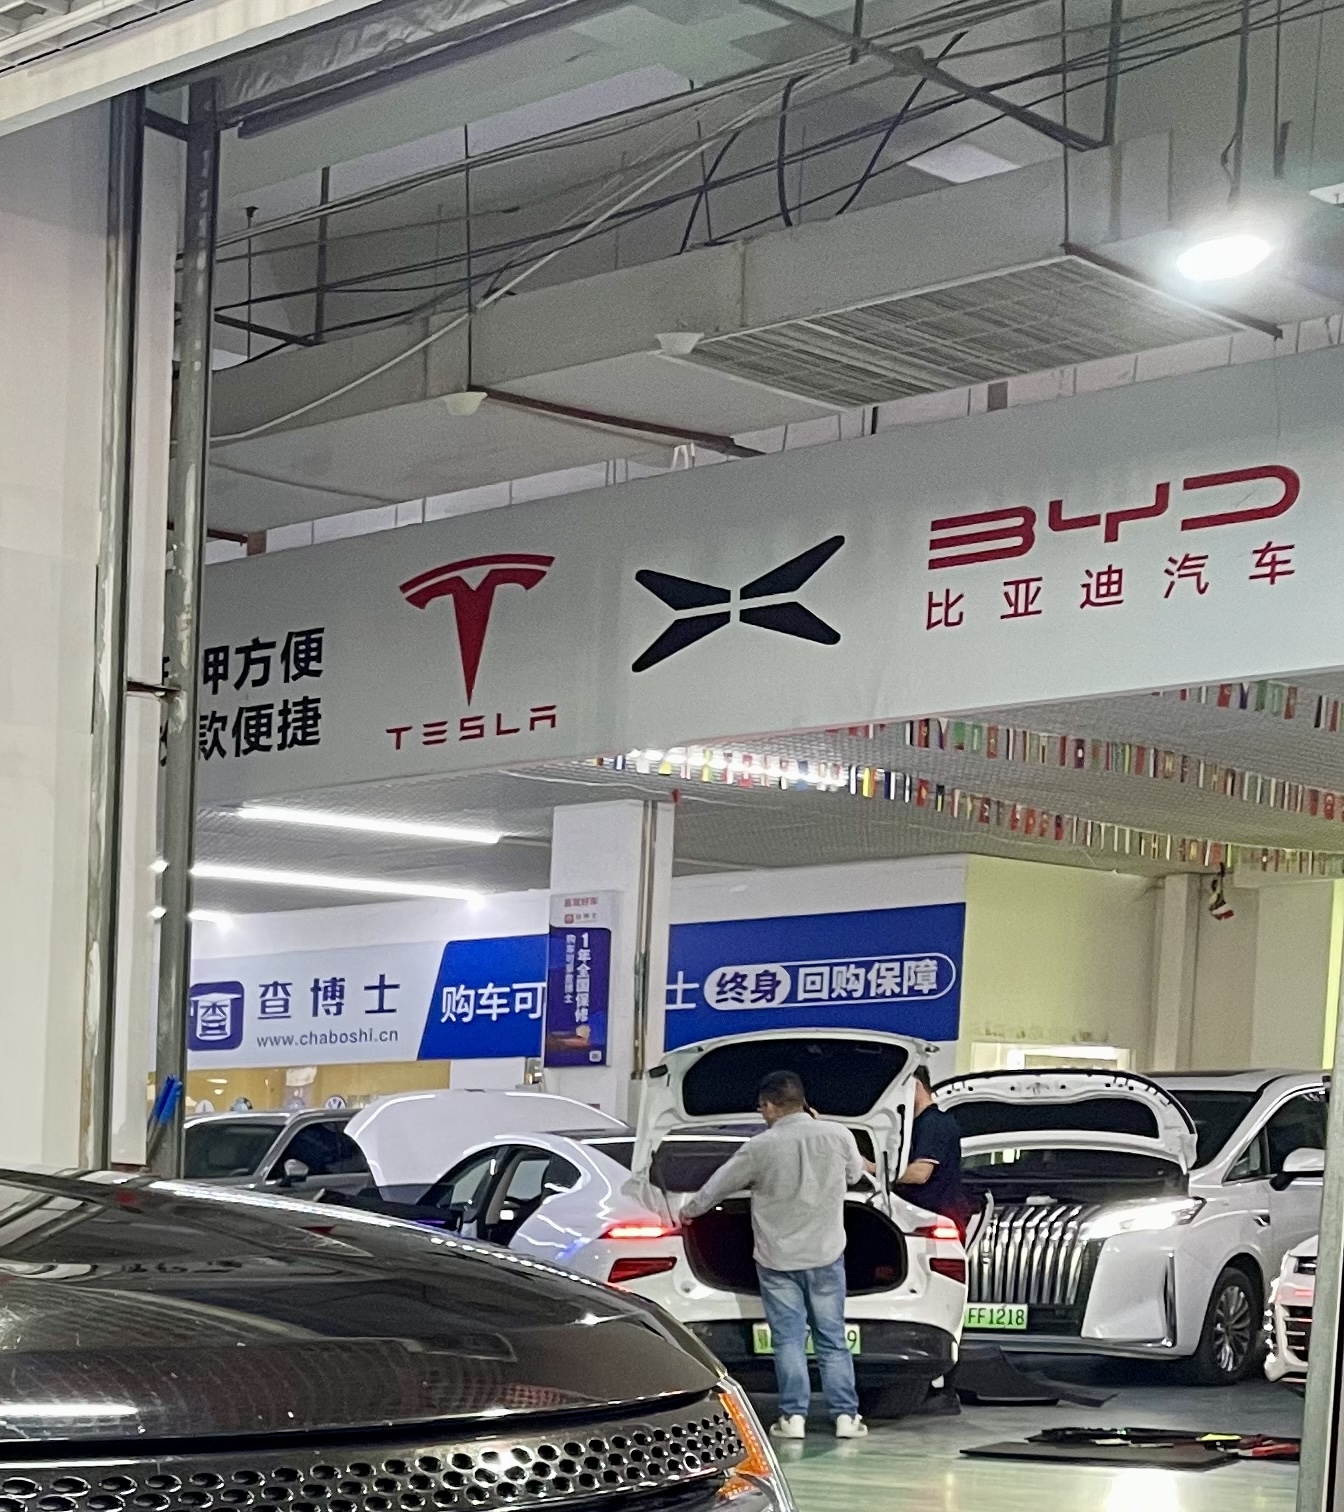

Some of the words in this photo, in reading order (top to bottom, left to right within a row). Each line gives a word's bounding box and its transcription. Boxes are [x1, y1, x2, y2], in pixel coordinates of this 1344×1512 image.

[927, 465, 1301, 570] BYD
[925, 541, 1295, 630] 比亚迪汽车
[386, 705, 557, 750] TESLA
[257, 973, 400, 1020] 查博士
[440, 981, 548, 1024] 购车可
[714, 969, 783, 1004] 终身
[797, 957, 939, 1001] 回购保障
[256, 1026, 400, 1048] www.chaboshi.cn
